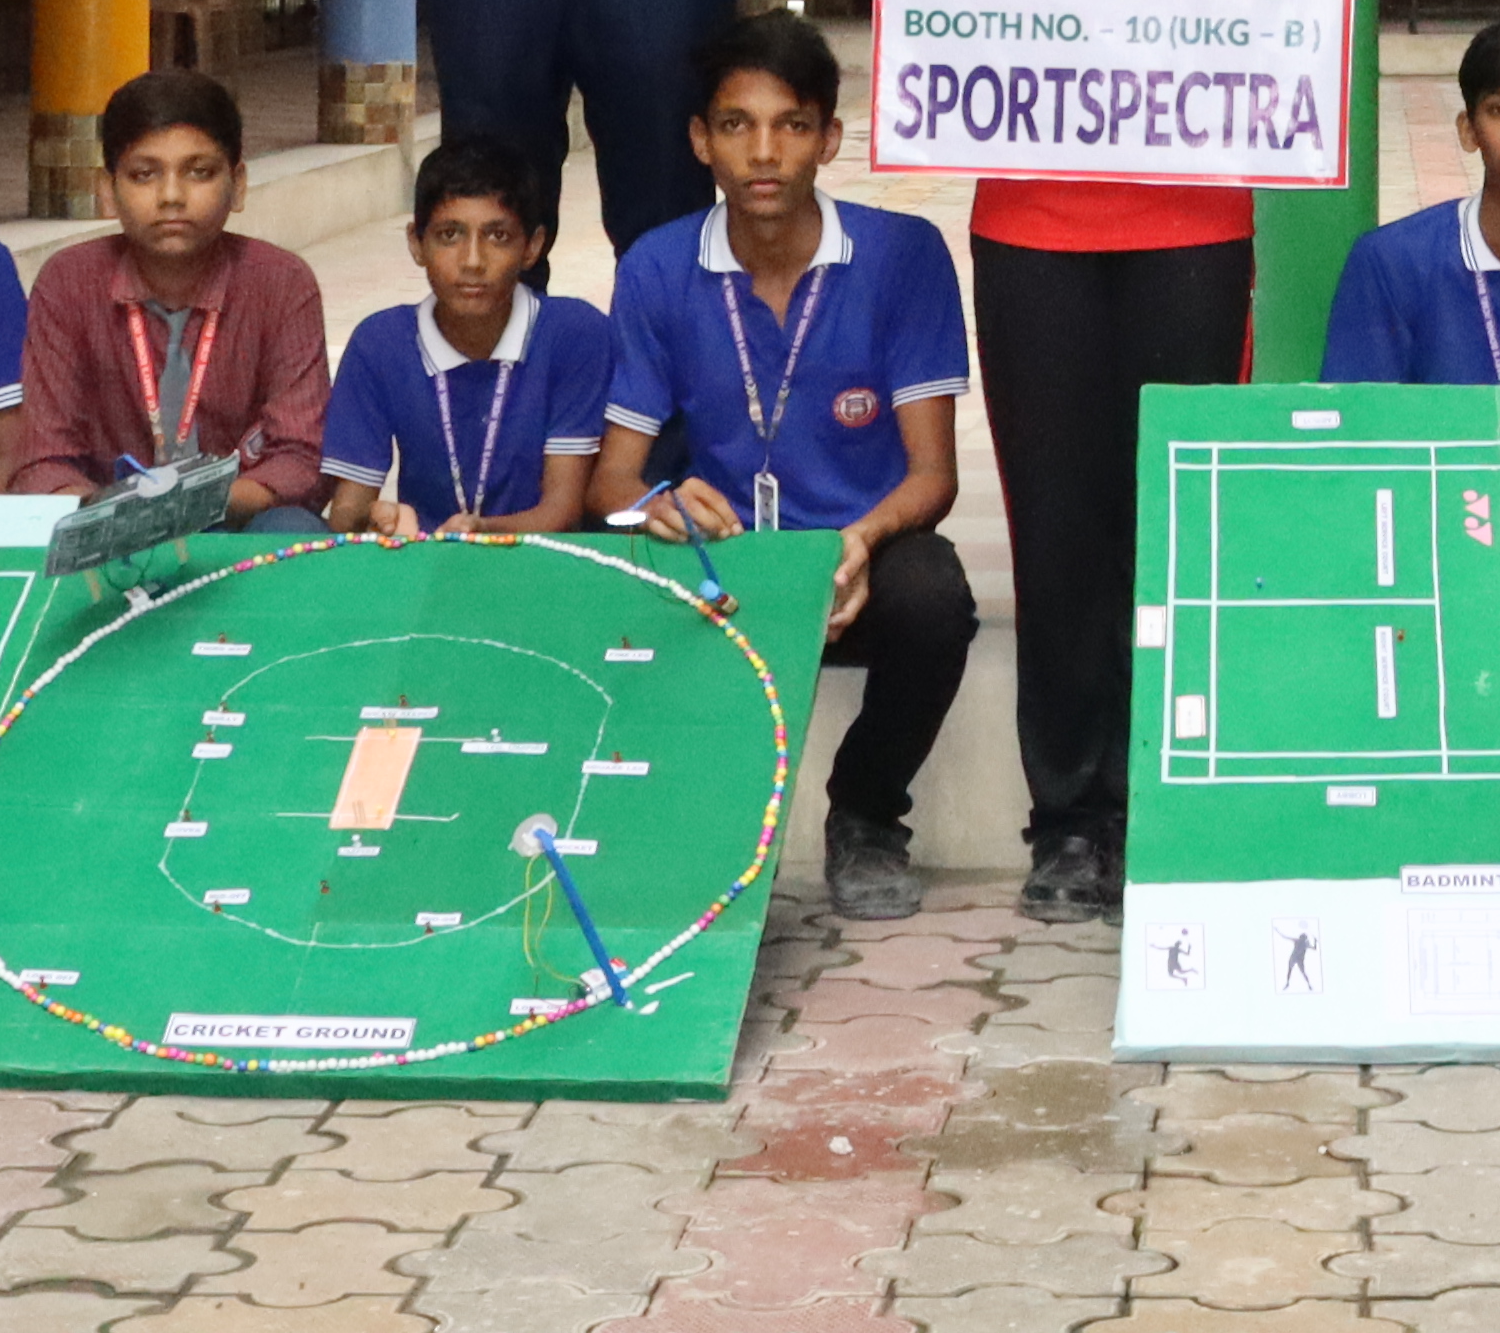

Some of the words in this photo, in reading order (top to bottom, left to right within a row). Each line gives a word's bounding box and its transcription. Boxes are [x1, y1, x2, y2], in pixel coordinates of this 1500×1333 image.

[904, 9, 1023, 42] BOOTH
[1031, 14, 1089, 43] NO.
[894, 63, 1324, 151] SPORTSPECTRA
[172, 1022, 280, 1039] CRICKET
[285, 1024, 407, 1042] GROUND
